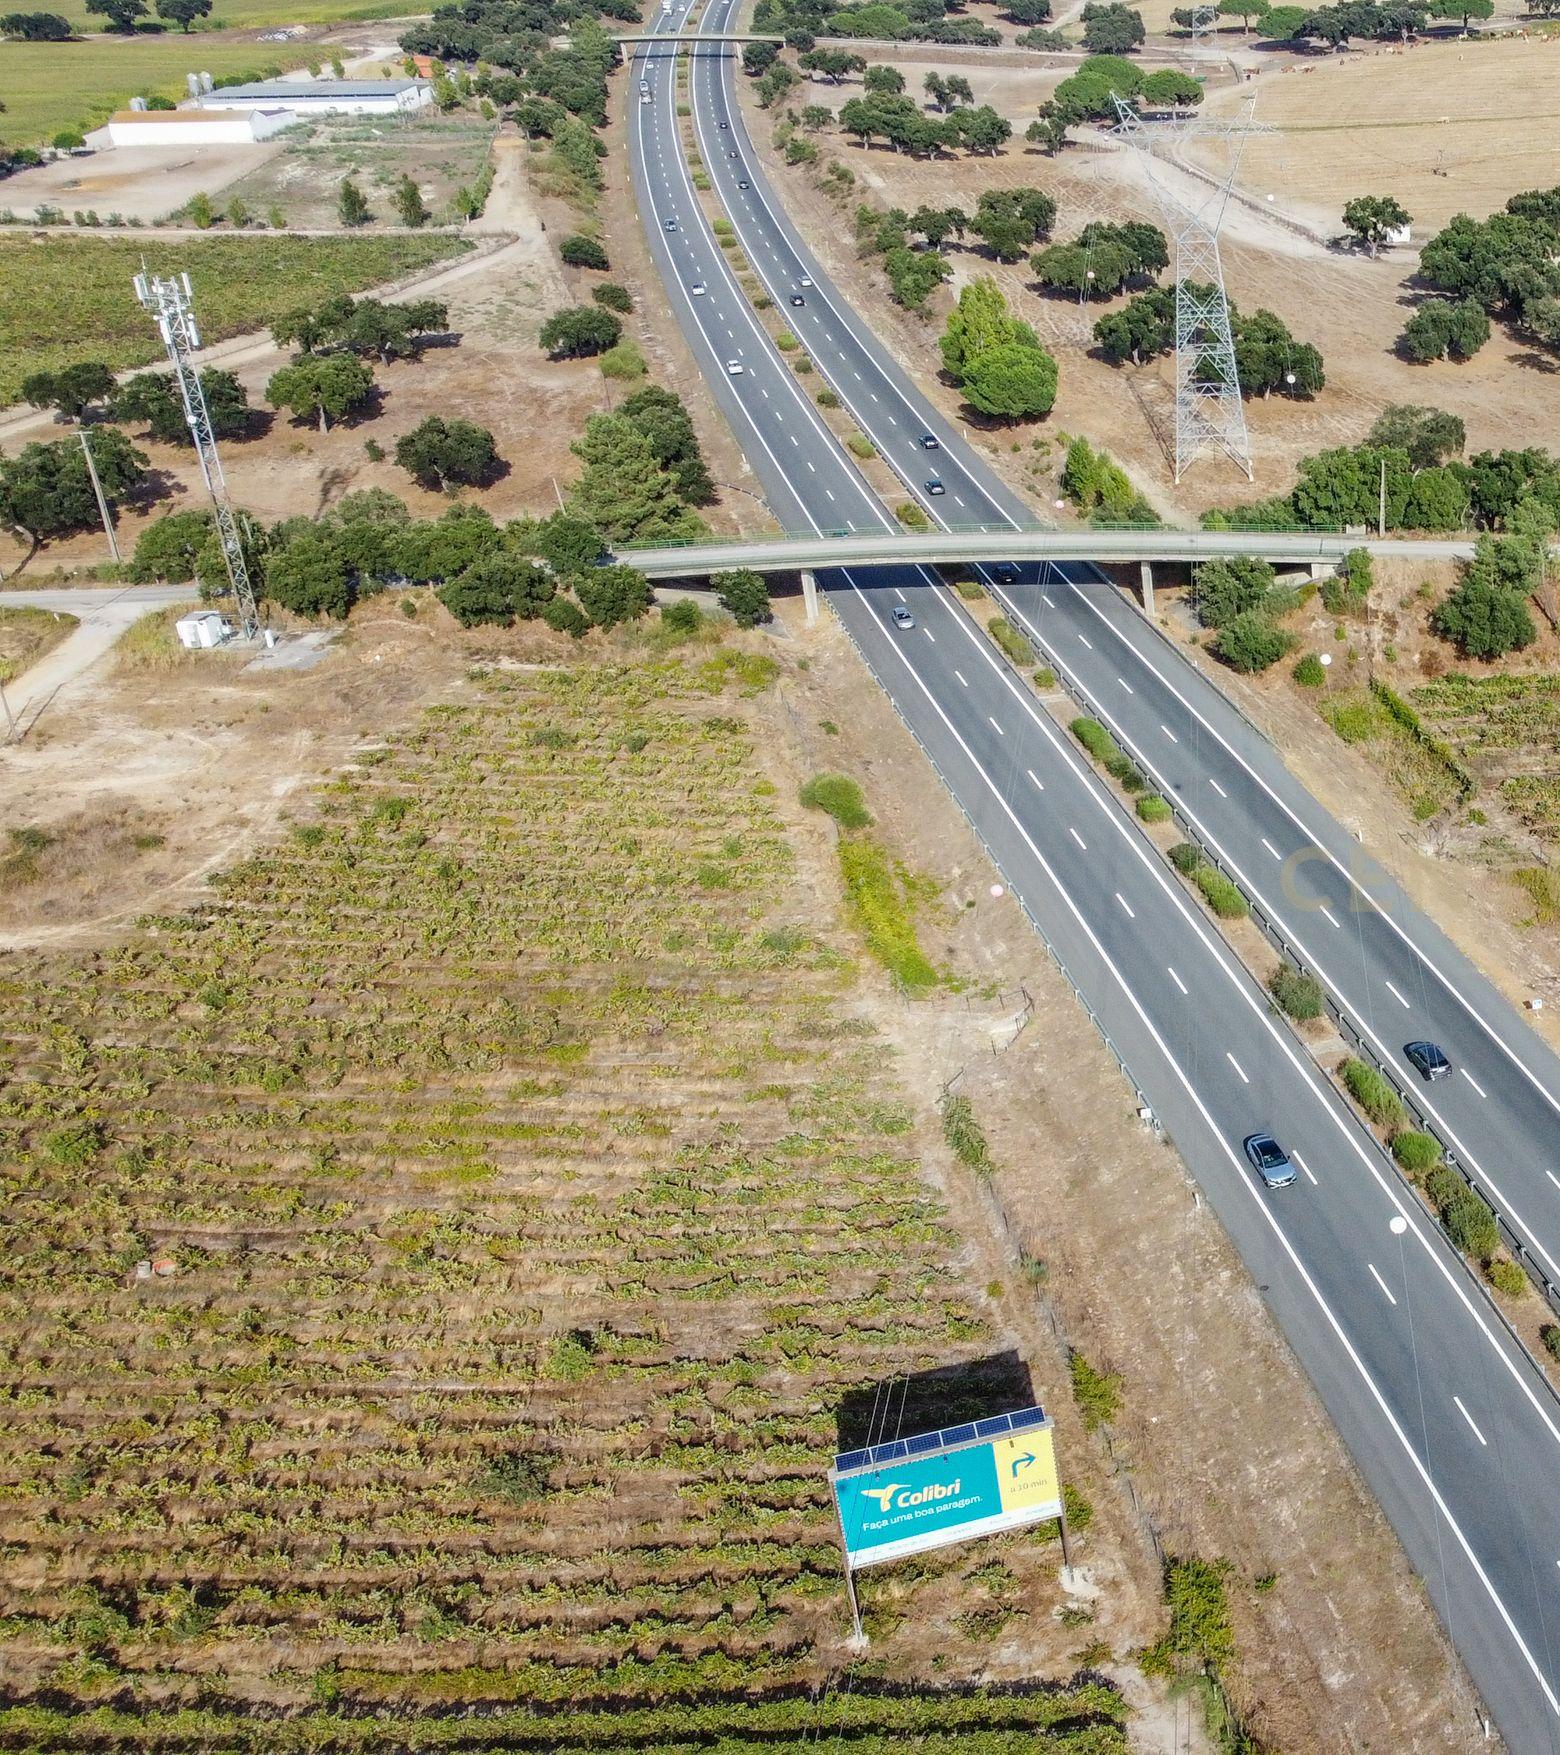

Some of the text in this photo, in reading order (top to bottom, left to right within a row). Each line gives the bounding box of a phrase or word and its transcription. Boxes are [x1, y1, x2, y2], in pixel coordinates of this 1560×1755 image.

[897, 1478, 961, 1508] Colibri
[863, 1520, 889, 1531] Faça
[891, 1513, 914, 1525] uma
[914, 1508, 935, 1519] boa
